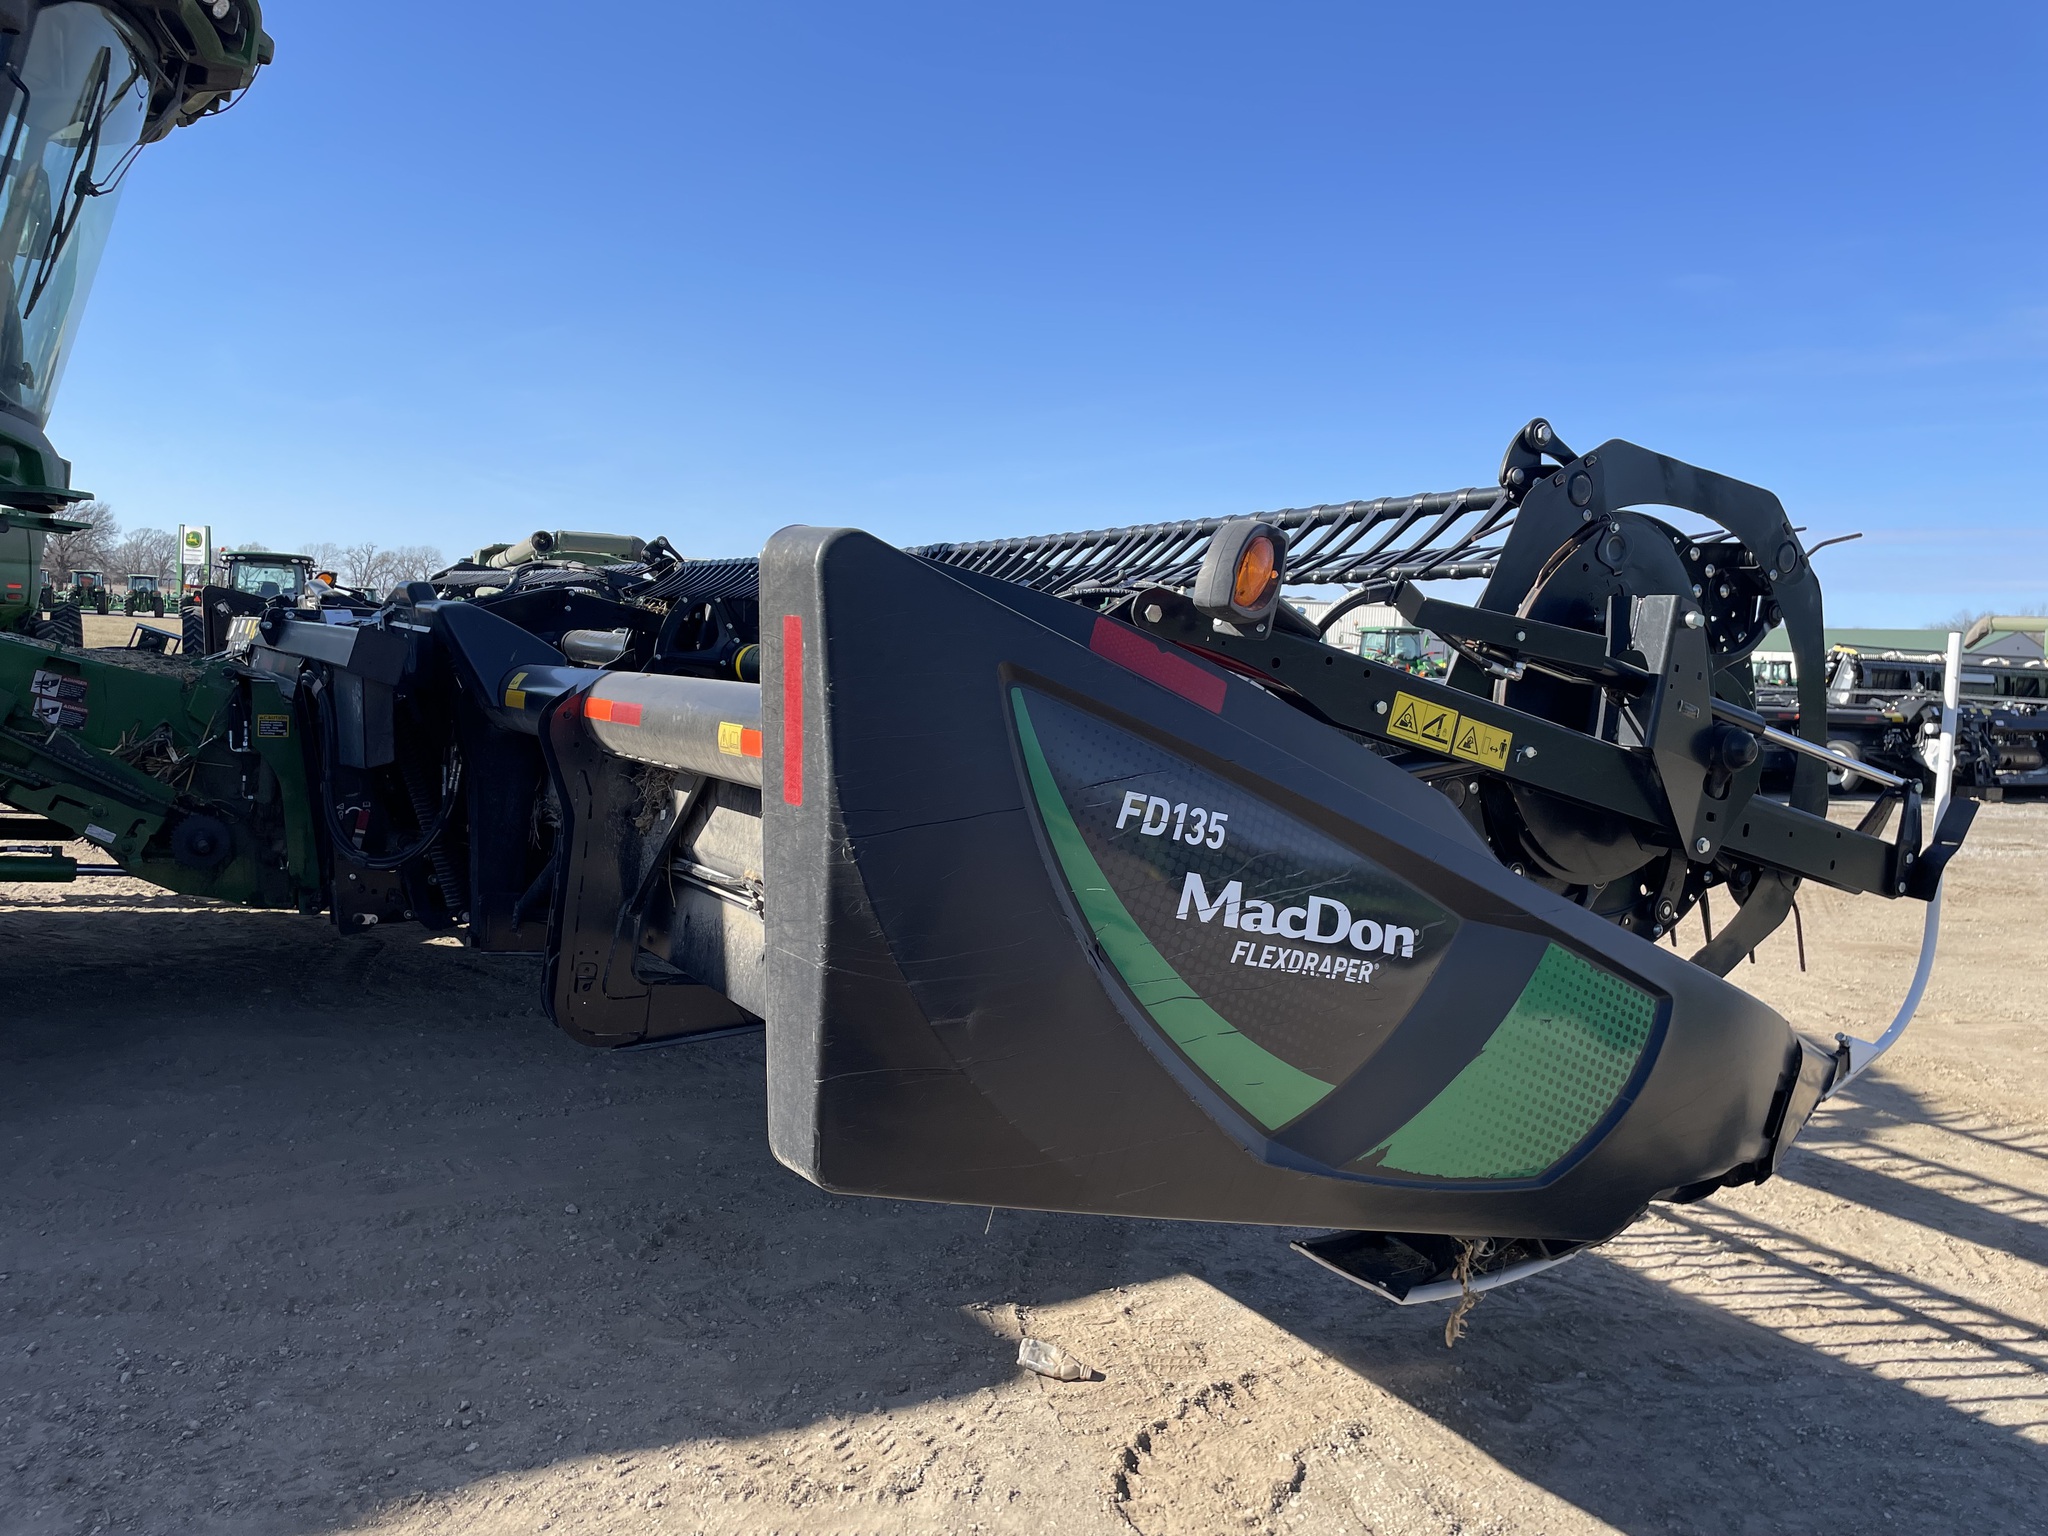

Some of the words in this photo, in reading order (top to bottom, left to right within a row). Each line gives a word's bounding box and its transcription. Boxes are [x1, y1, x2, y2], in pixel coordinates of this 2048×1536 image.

[1115, 790, 1229, 850] FD135
[1175, 871, 1415, 959] MacDon
[1230, 940, 1374, 984] FLEXDRAPER
